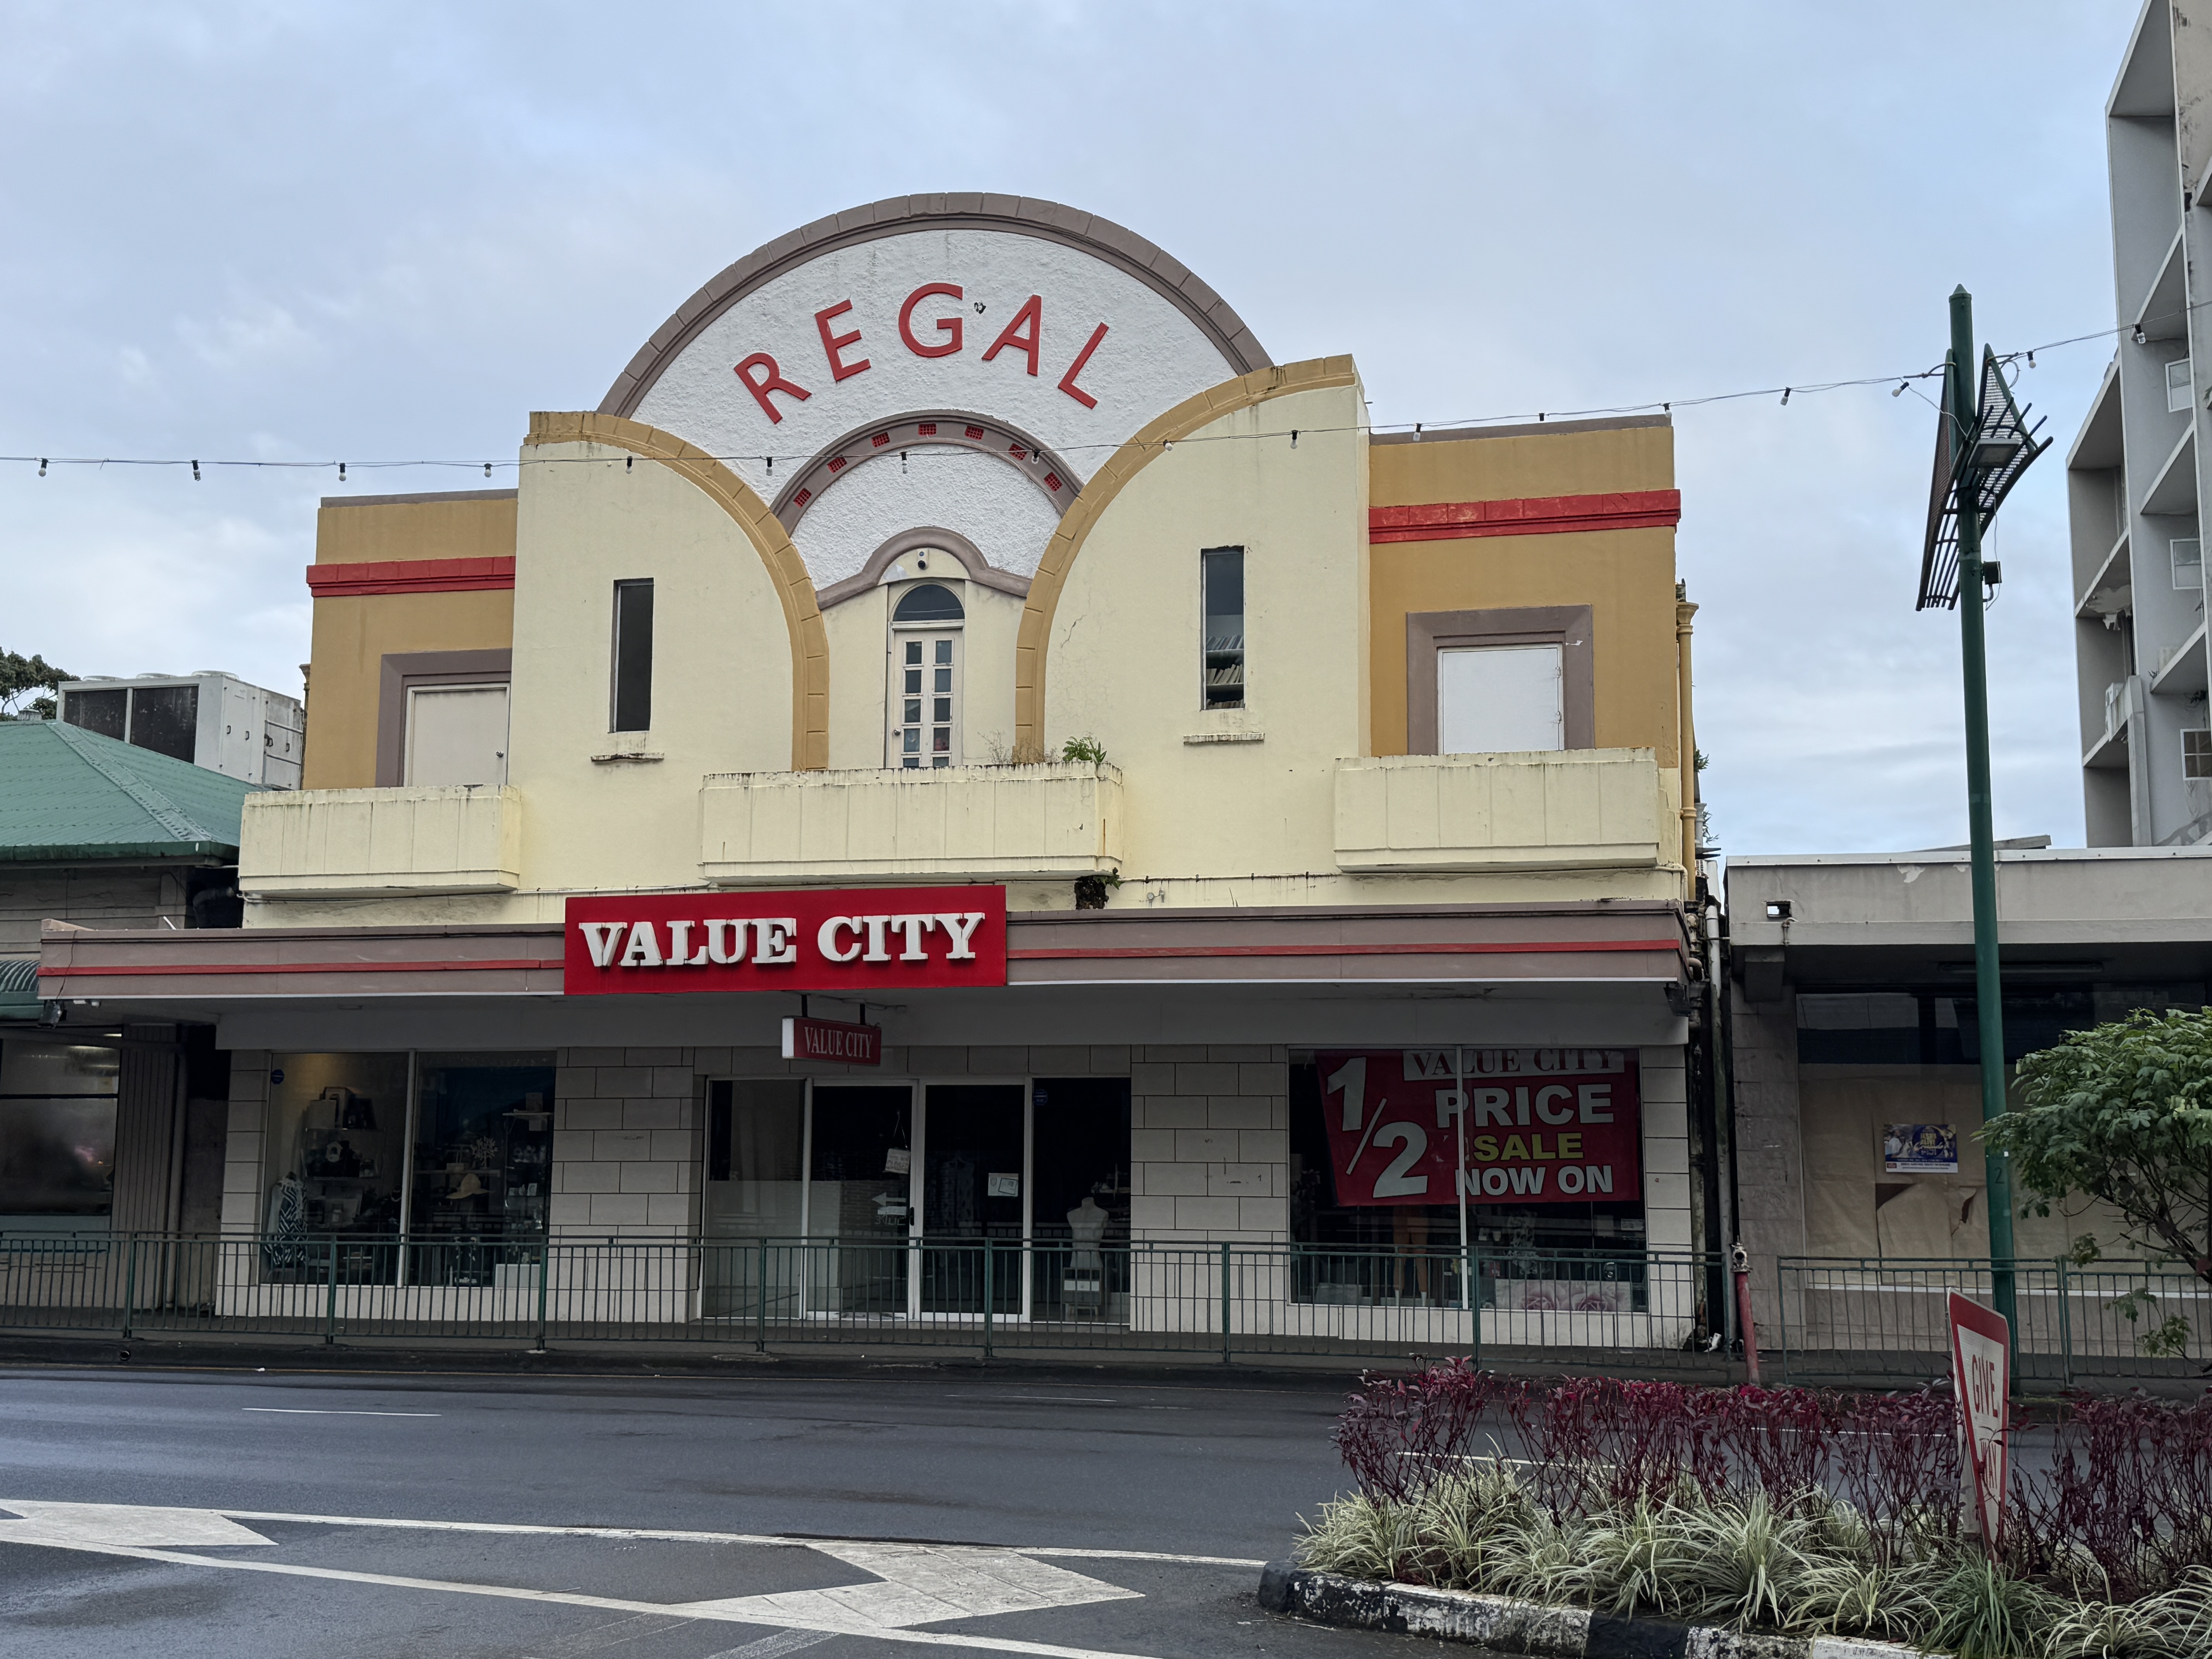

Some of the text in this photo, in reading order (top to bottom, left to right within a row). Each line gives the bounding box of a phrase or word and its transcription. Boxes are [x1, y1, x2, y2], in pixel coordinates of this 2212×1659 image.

[733, 282, 1109, 424] REGAL
[579, 912, 985, 967] VALUE CITY
[804, 1027, 873, 1058] VALUE CITY
[1534, 1049, 1615, 1071] CITY
[1327, 1056, 1429, 1199] 1/2
[1435, 1083, 1615, 1128] PRICE
[1474, 1133, 1584, 1162] SALE
[1455, 1165, 1614, 1197] NOW ON
[1994, 1166, 2005, 1184] 2
[1972, 1354, 1998, 1418] GIVE
[1980, 1441, 1997, 1489] WAY
